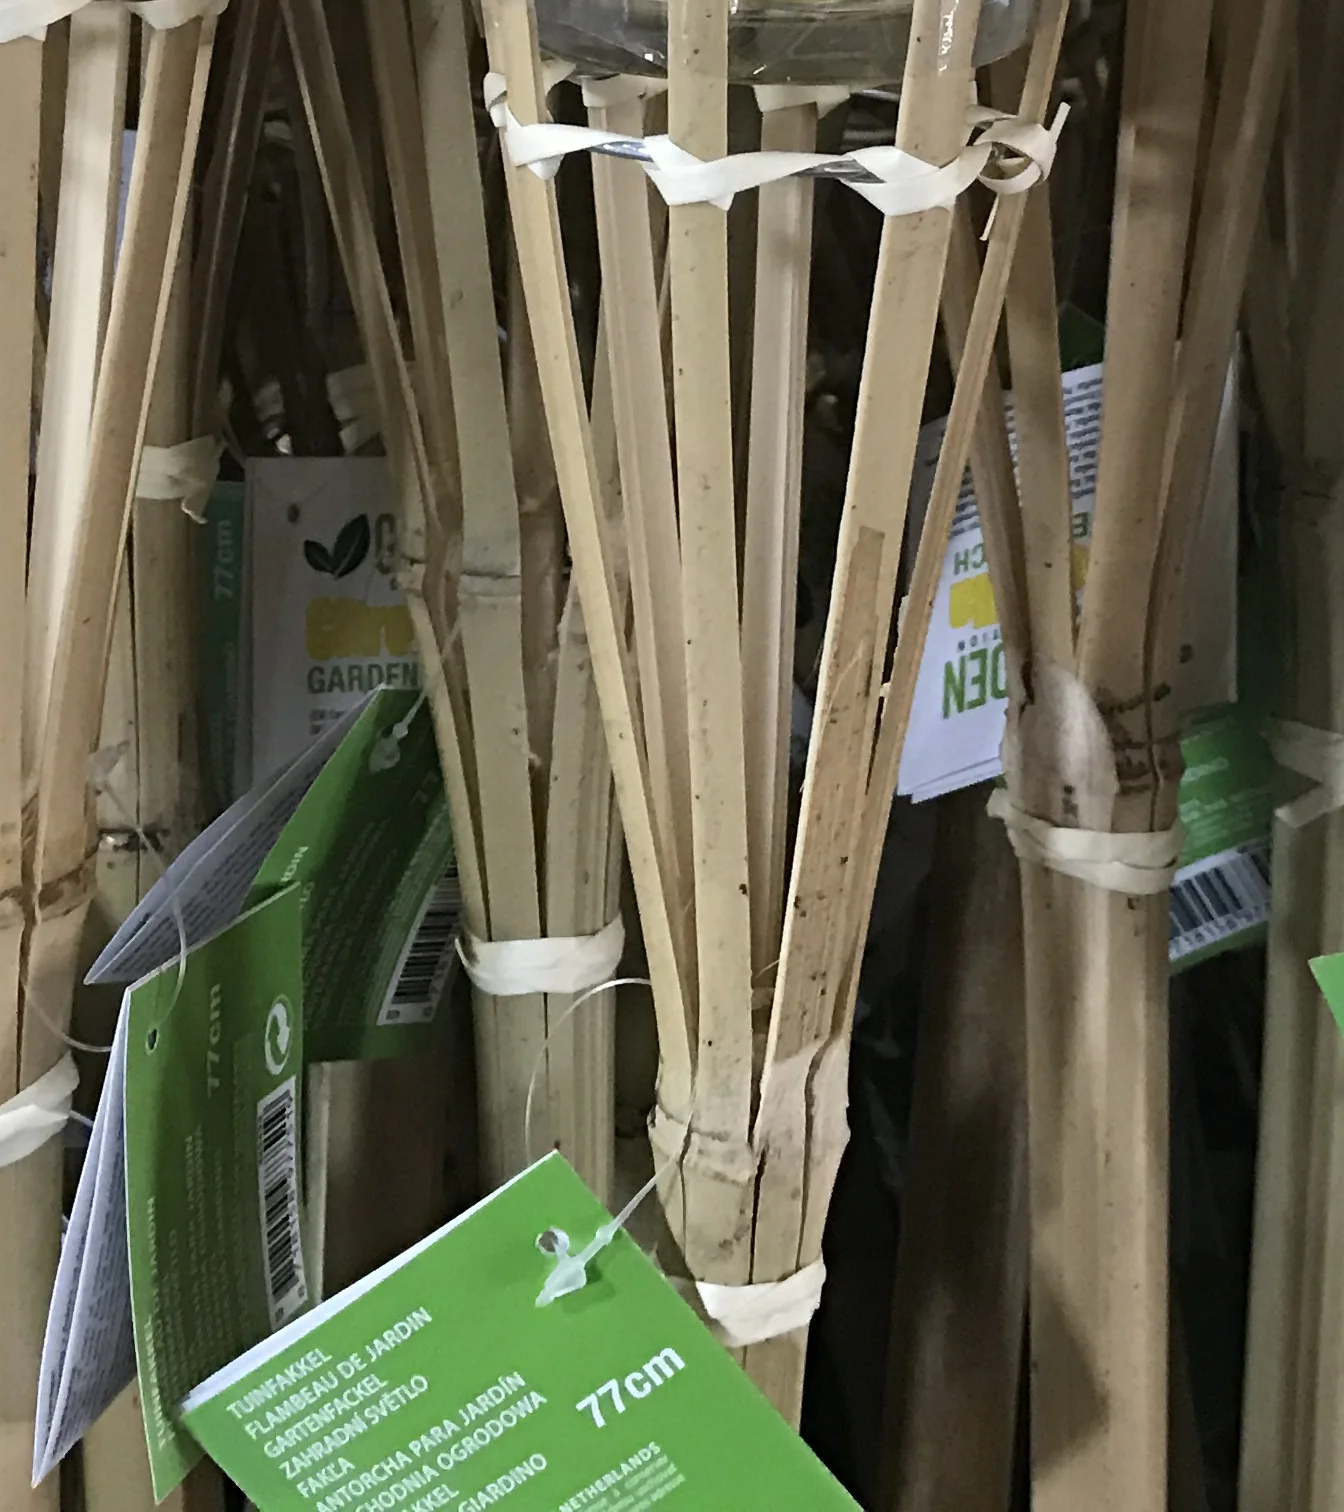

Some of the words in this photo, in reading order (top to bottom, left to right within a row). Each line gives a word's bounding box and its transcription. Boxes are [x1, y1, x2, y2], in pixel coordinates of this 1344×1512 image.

[943, 638, 1009, 720] DEN
[206, 983, 222, 1100] 77cm
[226, 1348, 332, 1419] TUINFAKKEL
[244, 1371, 338, 1440] FLAMBEAU
[336, 1353, 367, 1379] DE
[365, 1306, 432, 1362] JARDIN
[263, 1373, 388, 1458] GARTENFACKEL
[575, 1347, 686, 1428] 77cm
[279, 1411, 368, 1480] ZAHRADNÍ
[363, 1375, 429, 1425] SVĚTLO
[315, 1450, 412, 1512] ANTORCHA
[409, 1419, 461, 1457] PARA
[458, 1372, 526, 1426] JARDÍN
[355, 1464, 439, 1512] CHODNIA
[437, 1390, 548, 1470] OGRODOWA
[404, 1484, 460, 1512] KKEL
[458, 1453, 548, 1512] GIARDINO
